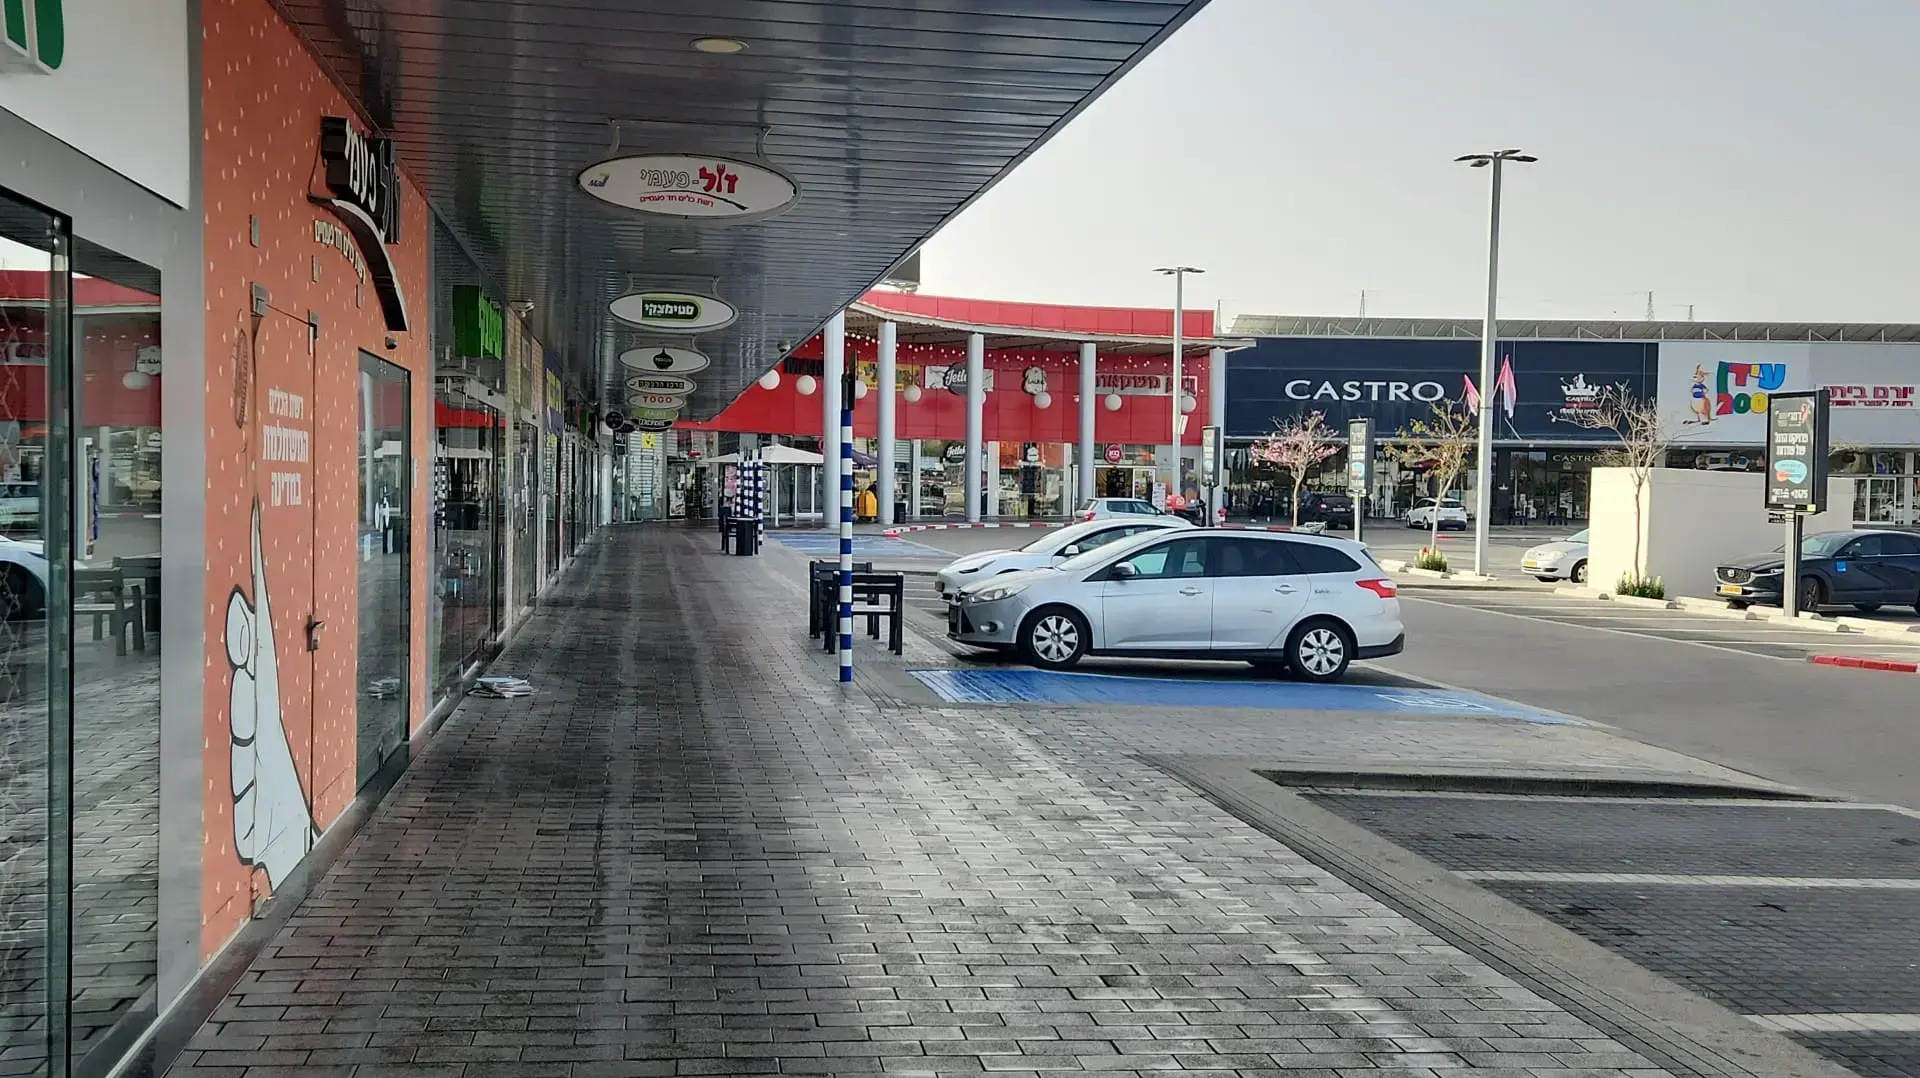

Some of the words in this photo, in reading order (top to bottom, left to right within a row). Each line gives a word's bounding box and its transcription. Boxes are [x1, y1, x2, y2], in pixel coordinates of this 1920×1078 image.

[678, 195, 696, 203] כלים
[697, 198, 714, 208] רשת
[644, 303, 695, 316] סטימצקי
[1285, 380, 1445, 402] CASTRO
[1873, 386, 1914, 399] יורם
[1552, 454, 1603, 463] CASTRO
[271, 472, 301, 507] במדינה
